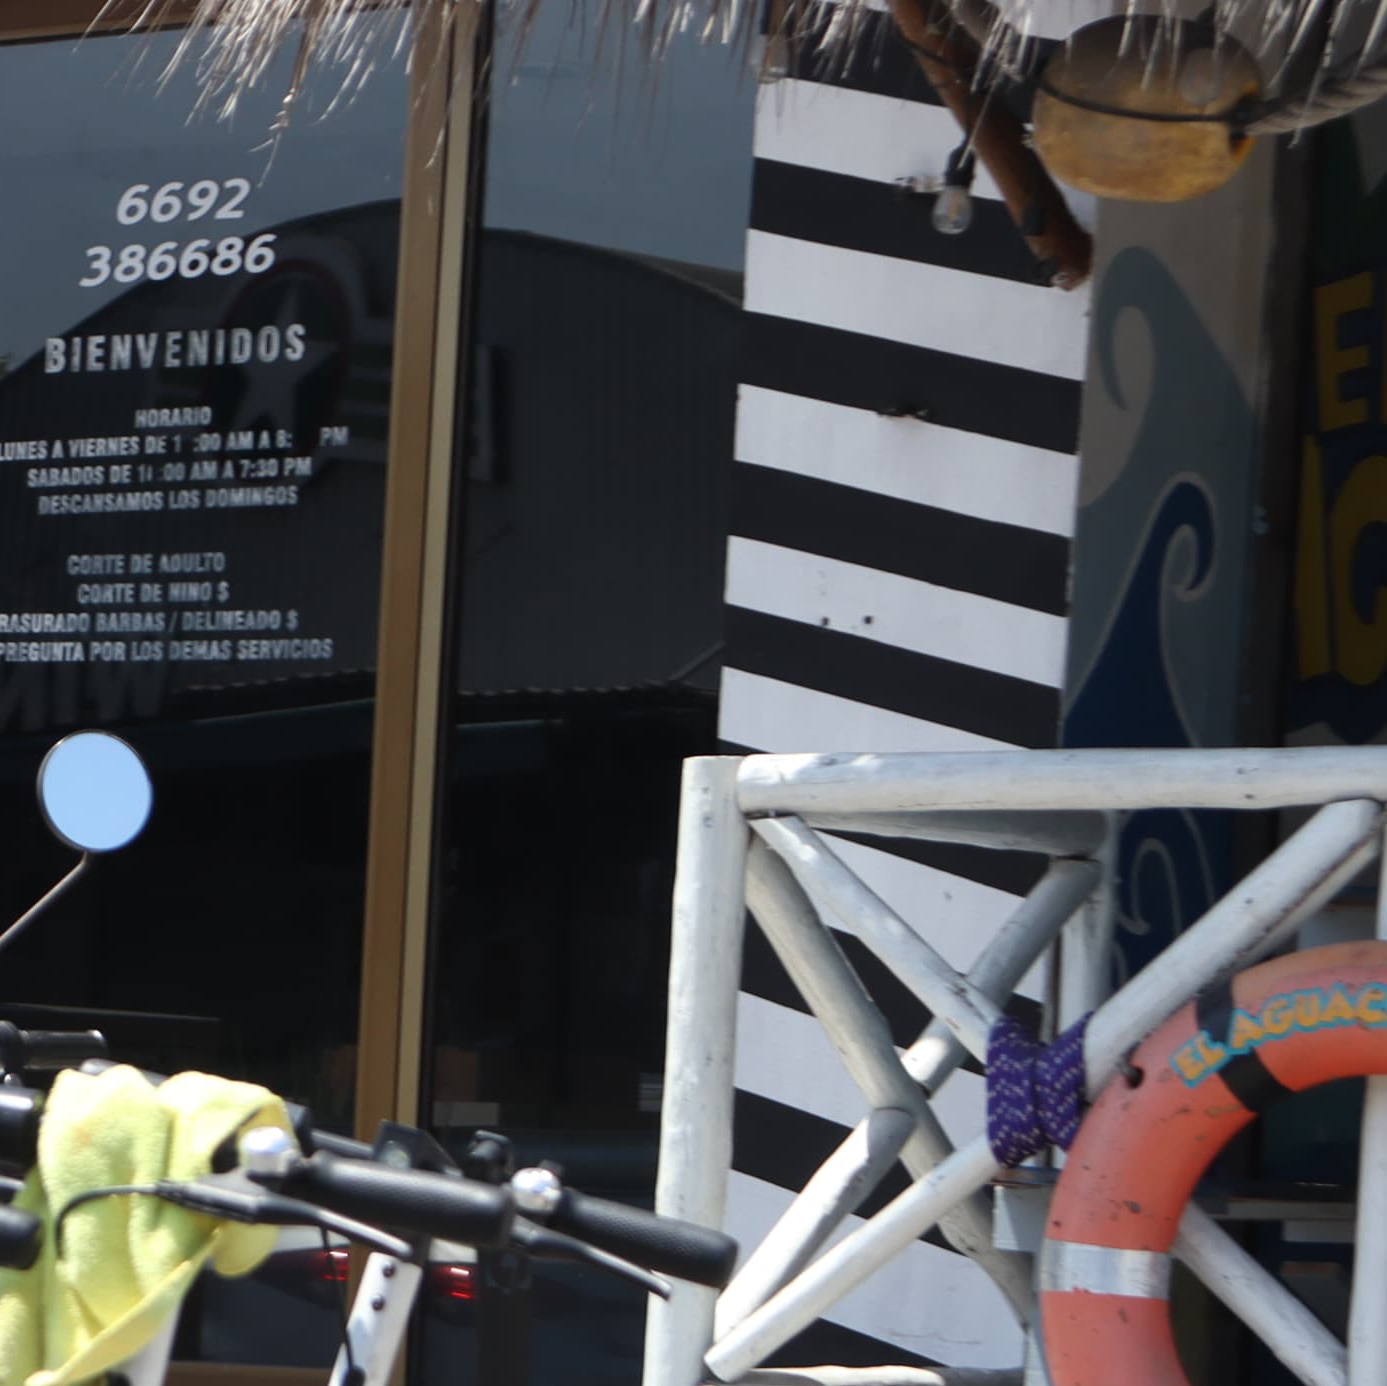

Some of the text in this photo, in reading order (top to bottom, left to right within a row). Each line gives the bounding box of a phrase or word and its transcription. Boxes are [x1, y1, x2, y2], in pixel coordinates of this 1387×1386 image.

[116, 177, 251, 225] 6692
[79, 233, 277, 287] 386686
[43, 323, 308, 374] BIENVENIDOS
[134, 406, 212, 429] HORARIO
[51, 440, 64, 459] A
[67, 436, 141, 458] VIERNES
[144, 435, 167, 454] DE
[228, 431, 254, 450] AM
[258, 431, 272, 450] A
[319, 426, 350, 447] PM
[26, 466, 106, 488] SABADOS
[109, 464, 132, 484] DE
[189, 460, 218, 481] AM
[221, 460, 234, 479] A
[240, 458, 280, 479] 7:30
[283, 456, 313, 477] PM
[38, 486, 300, 516] DESCANSAMOS LOS DOMINGOS
[66, 552, 227, 575] CORTE DE ADULTO
[77, 582, 136, 604] CORTE
[139, 582, 163, 603] DE
[217, 580, 230, 601] $
[94, 611, 167, 633] BARBAS
[181, 610, 282, 632] DELINEADO
[285, 609, 299, 631] $
[89, 640, 127, 662] POR
[130, 640, 164, 662] LOS
[168, 640, 231, 662] DEMAS
[236, 637, 334, 661] SERVICIOS
[1170, 983, 1387, 1087] EL AGUAC
